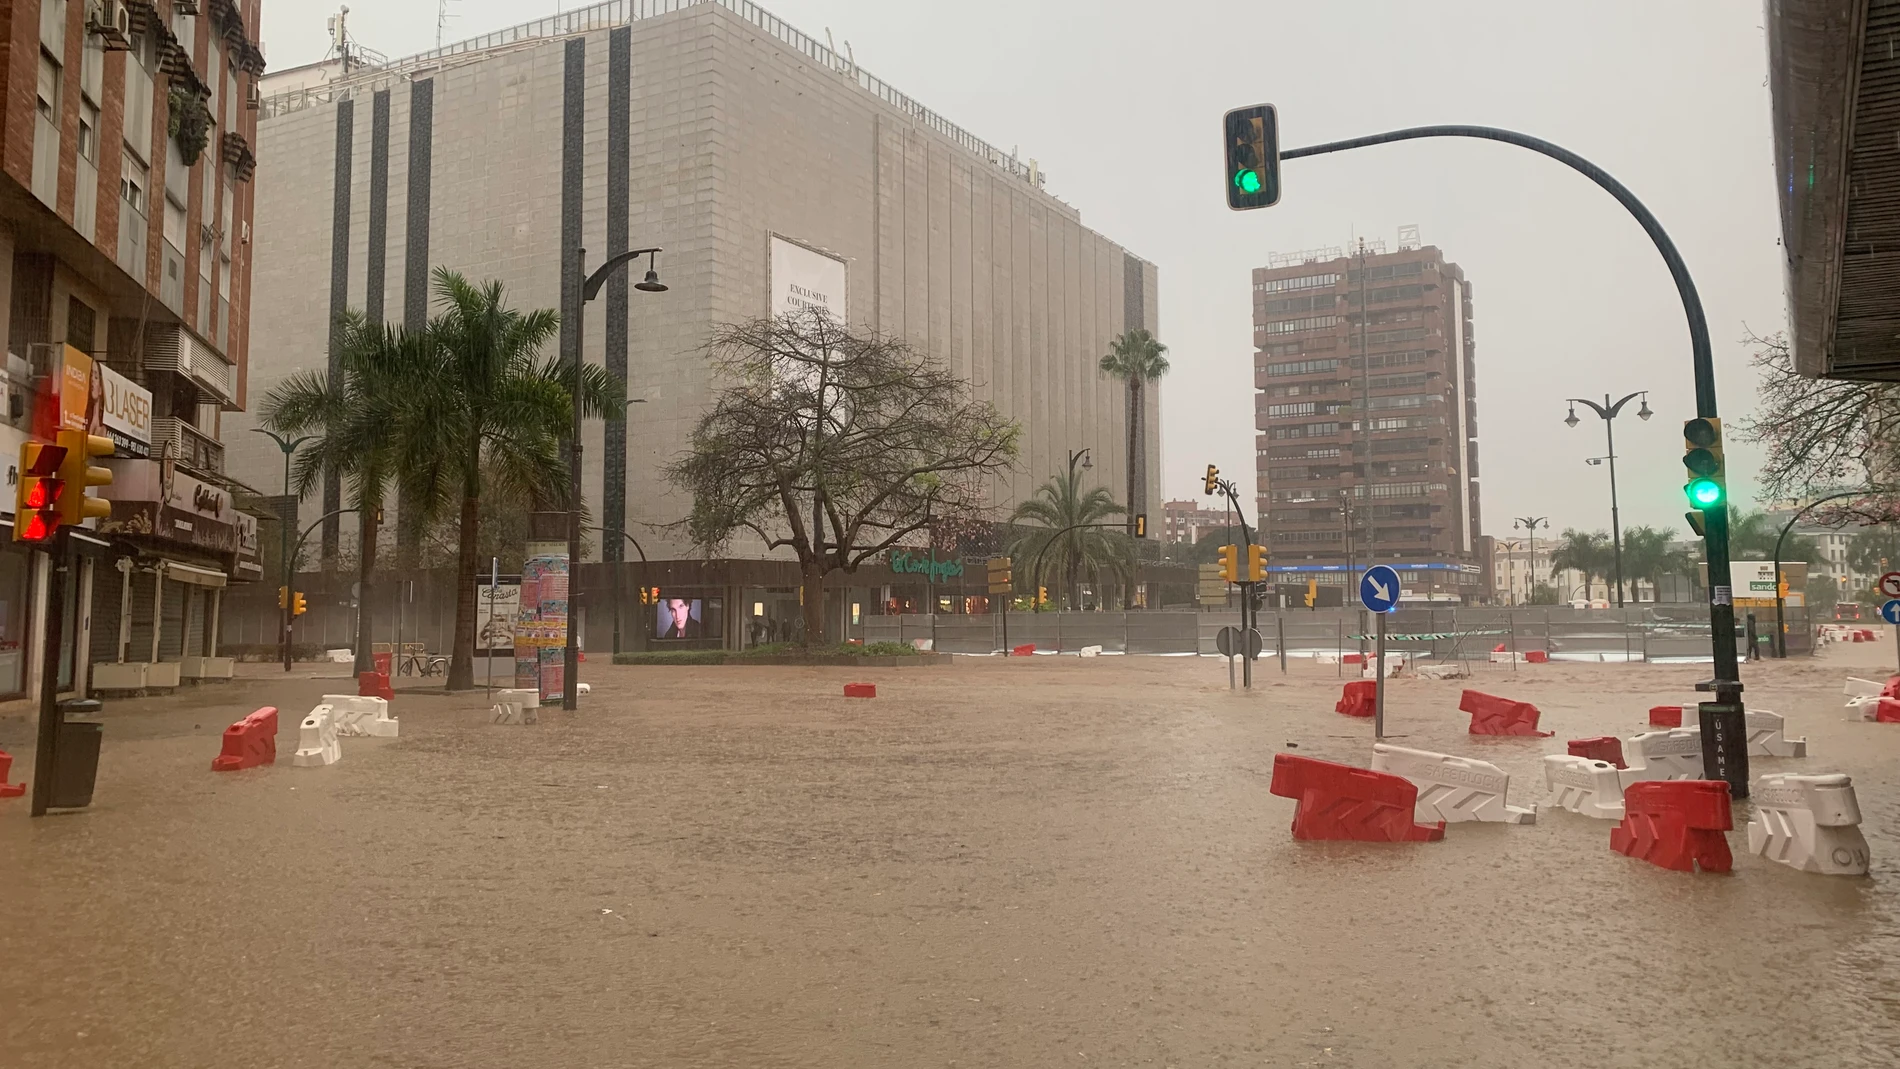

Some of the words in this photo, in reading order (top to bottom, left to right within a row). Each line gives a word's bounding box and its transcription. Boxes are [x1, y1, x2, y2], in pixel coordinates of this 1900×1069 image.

[790, 283, 828, 304] EXCLUSIVE
[1715, 719, 1726, 777] ÚSAME
[1424, 763, 1502, 790] SAFEBLOCK
